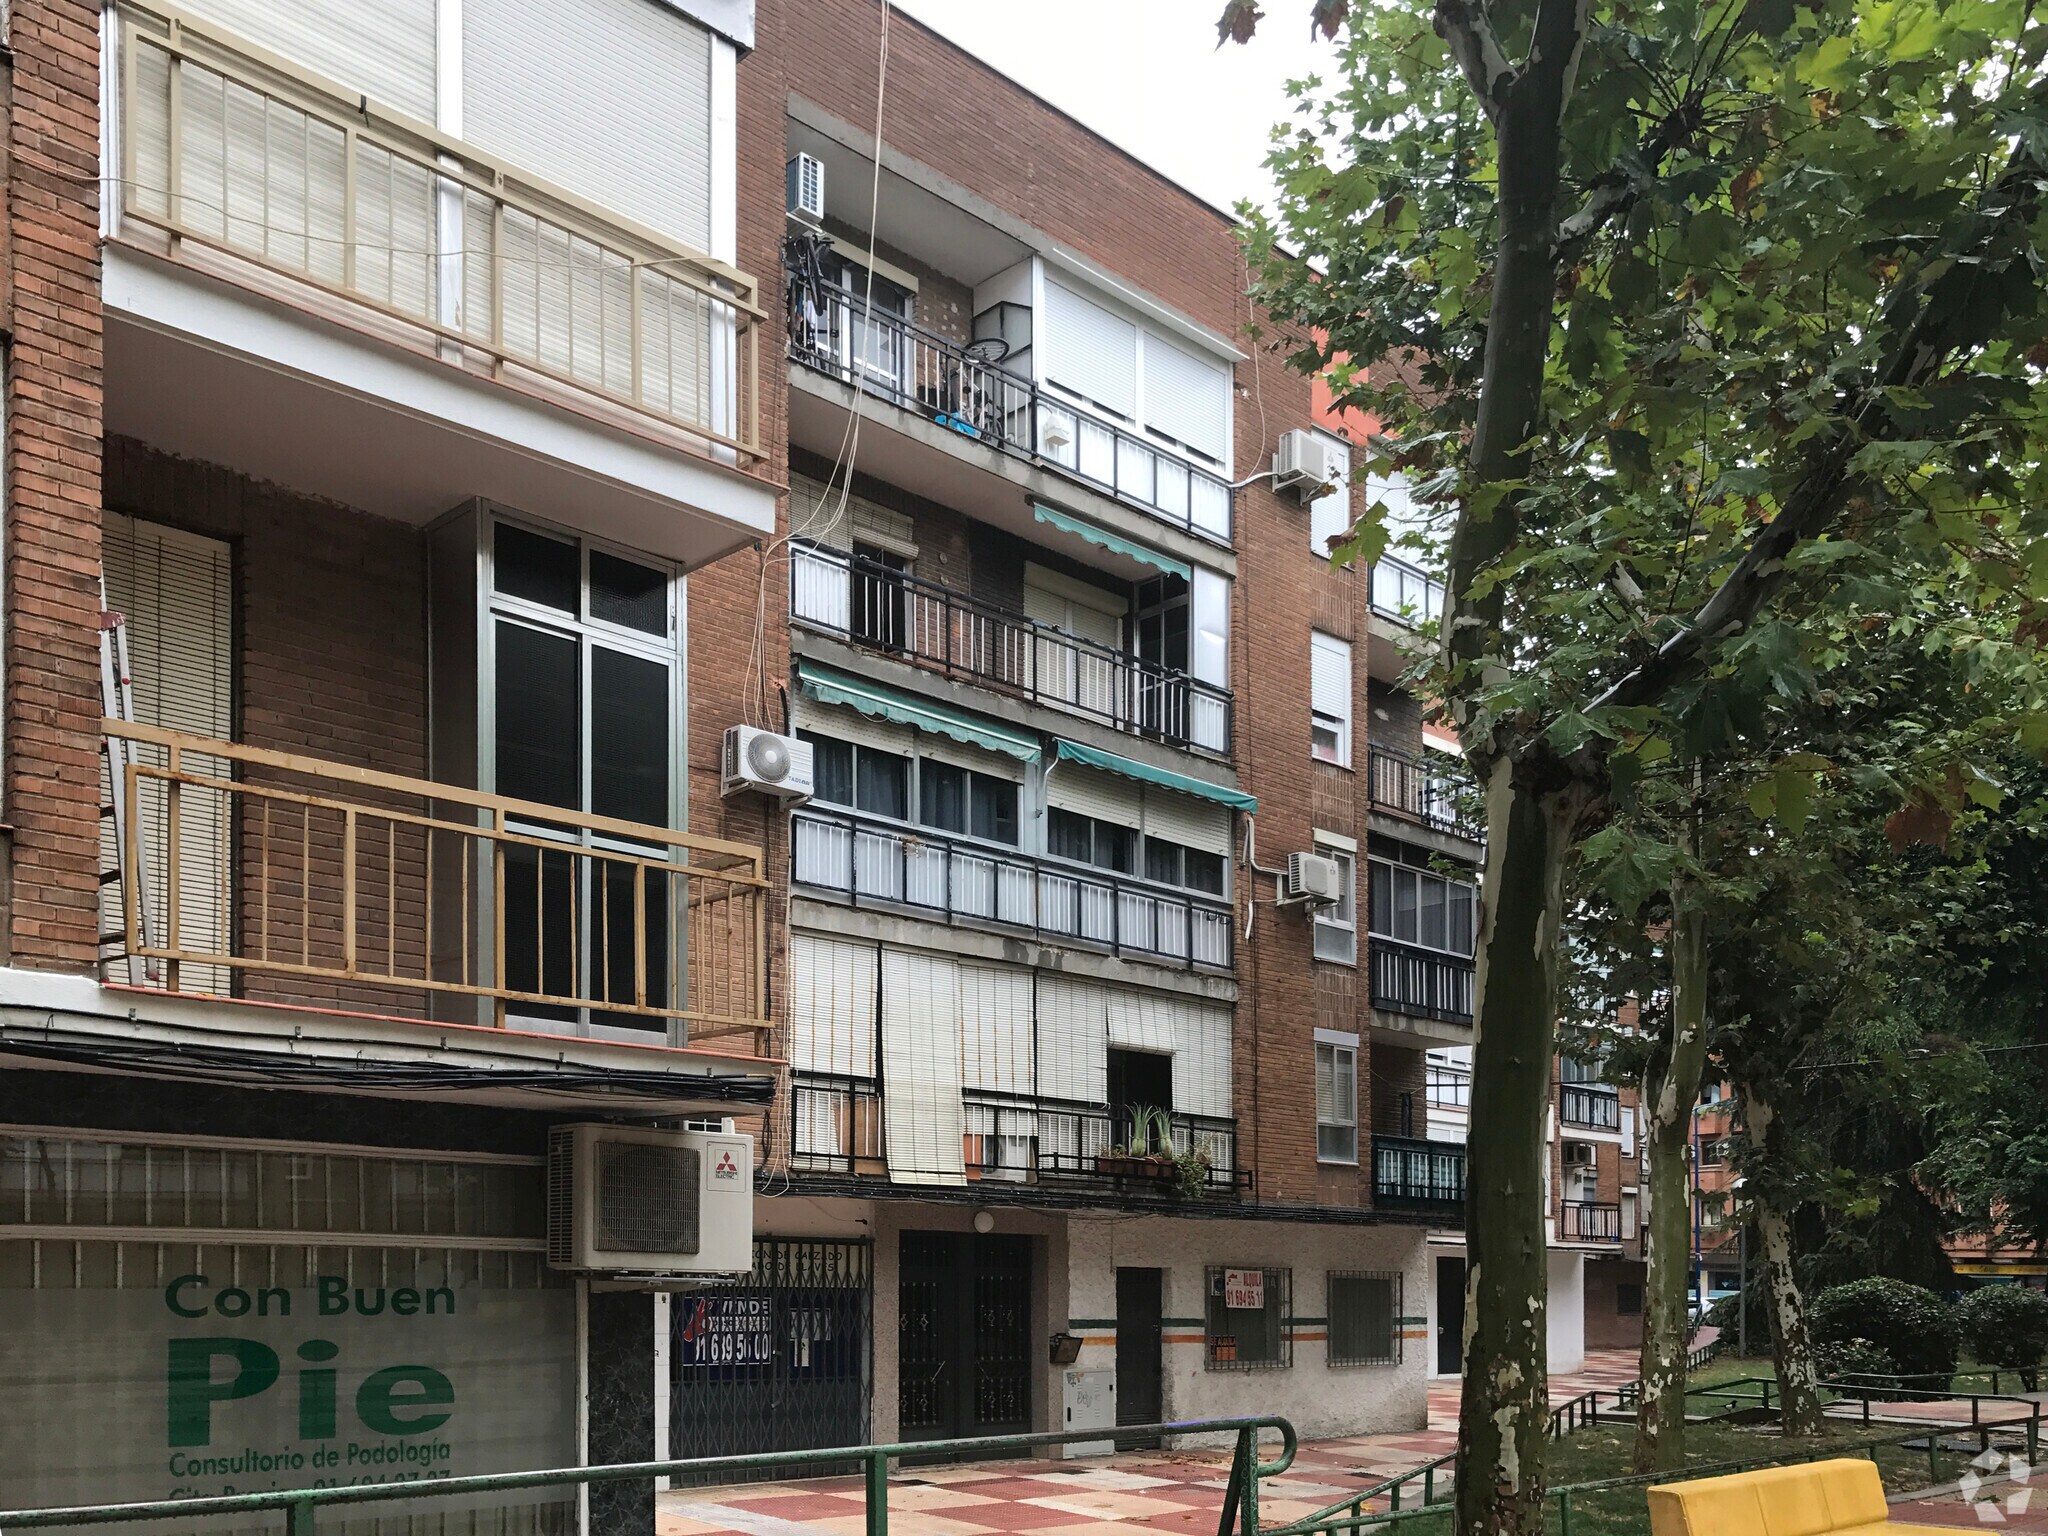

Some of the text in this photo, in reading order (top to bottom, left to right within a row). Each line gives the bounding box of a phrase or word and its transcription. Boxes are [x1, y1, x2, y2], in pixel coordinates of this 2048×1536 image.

[165, 1275, 456, 1318] Con Buen
[168, 1337, 455, 1447] Pie
[169, 1437, 451, 1478] Consultorio de Podología
